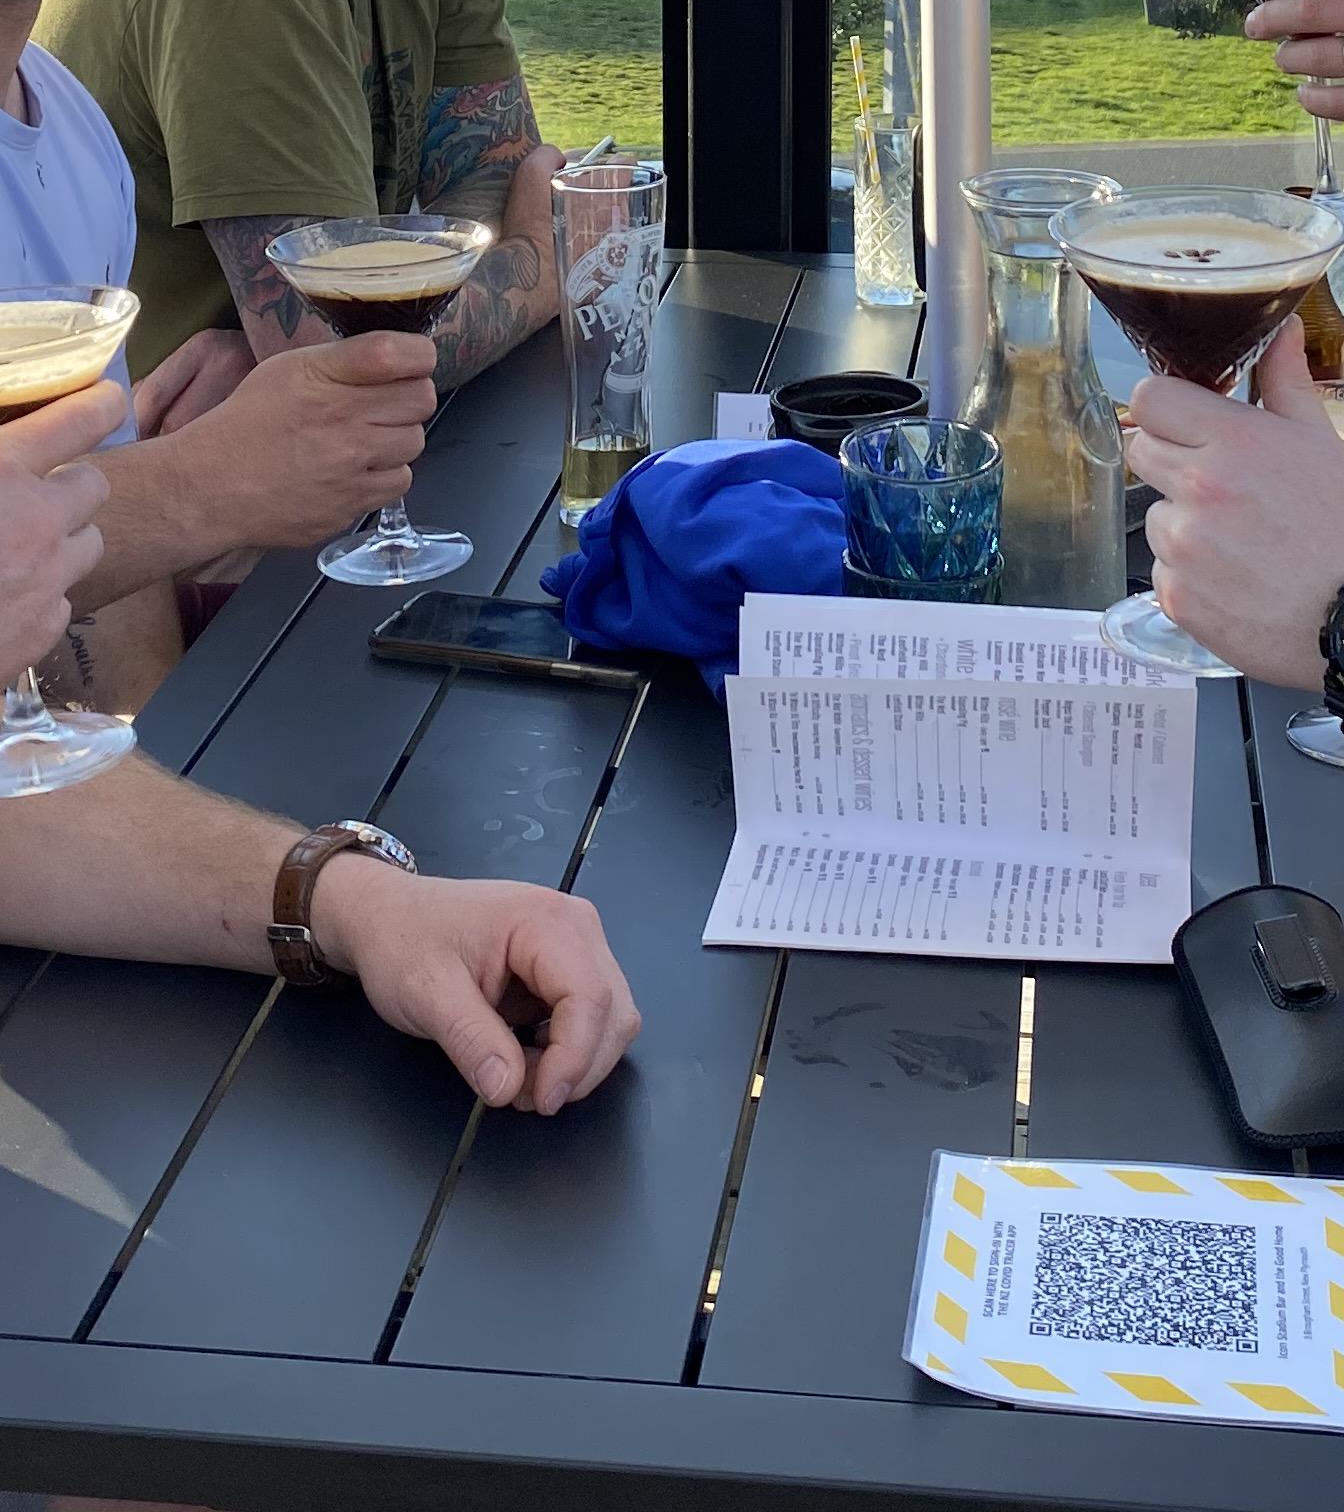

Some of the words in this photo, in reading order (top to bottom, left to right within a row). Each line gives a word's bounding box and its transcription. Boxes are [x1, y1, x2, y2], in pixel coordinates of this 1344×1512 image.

[956, 639, 978, 674] white
[988, 1267, 999, 1277] TO
[985, 1279, 997, 1298] HERE
[982, 1299, 995, 1318] SCAN
[997, 1303, 1009, 1317] THE
